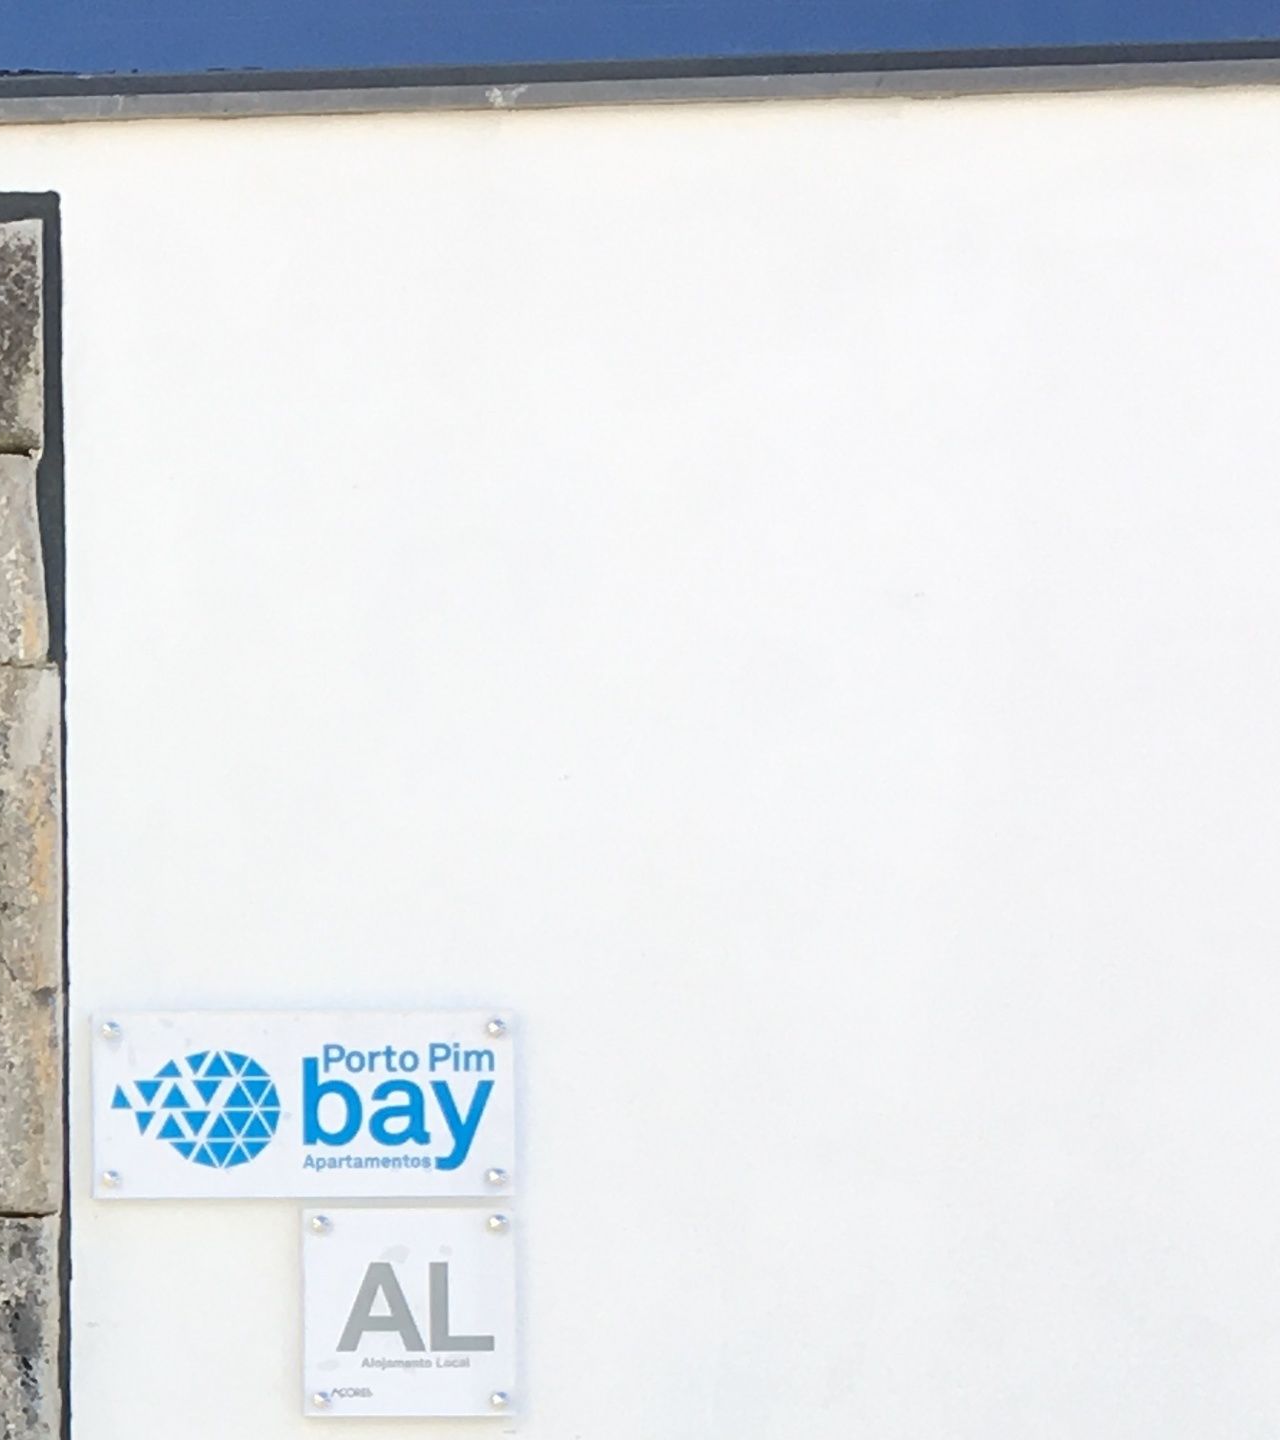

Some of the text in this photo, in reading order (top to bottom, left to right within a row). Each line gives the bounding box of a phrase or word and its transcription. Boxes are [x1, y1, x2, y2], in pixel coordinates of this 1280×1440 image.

[323, 1043, 495, 1073] Porto Pim
[302, 1057, 496, 1171] bay
[302, 1153, 432, 1170] Apartamentos
[336, 1261, 495, 1352] AL
[361, 1357, 471, 1370] Alojamento Local
